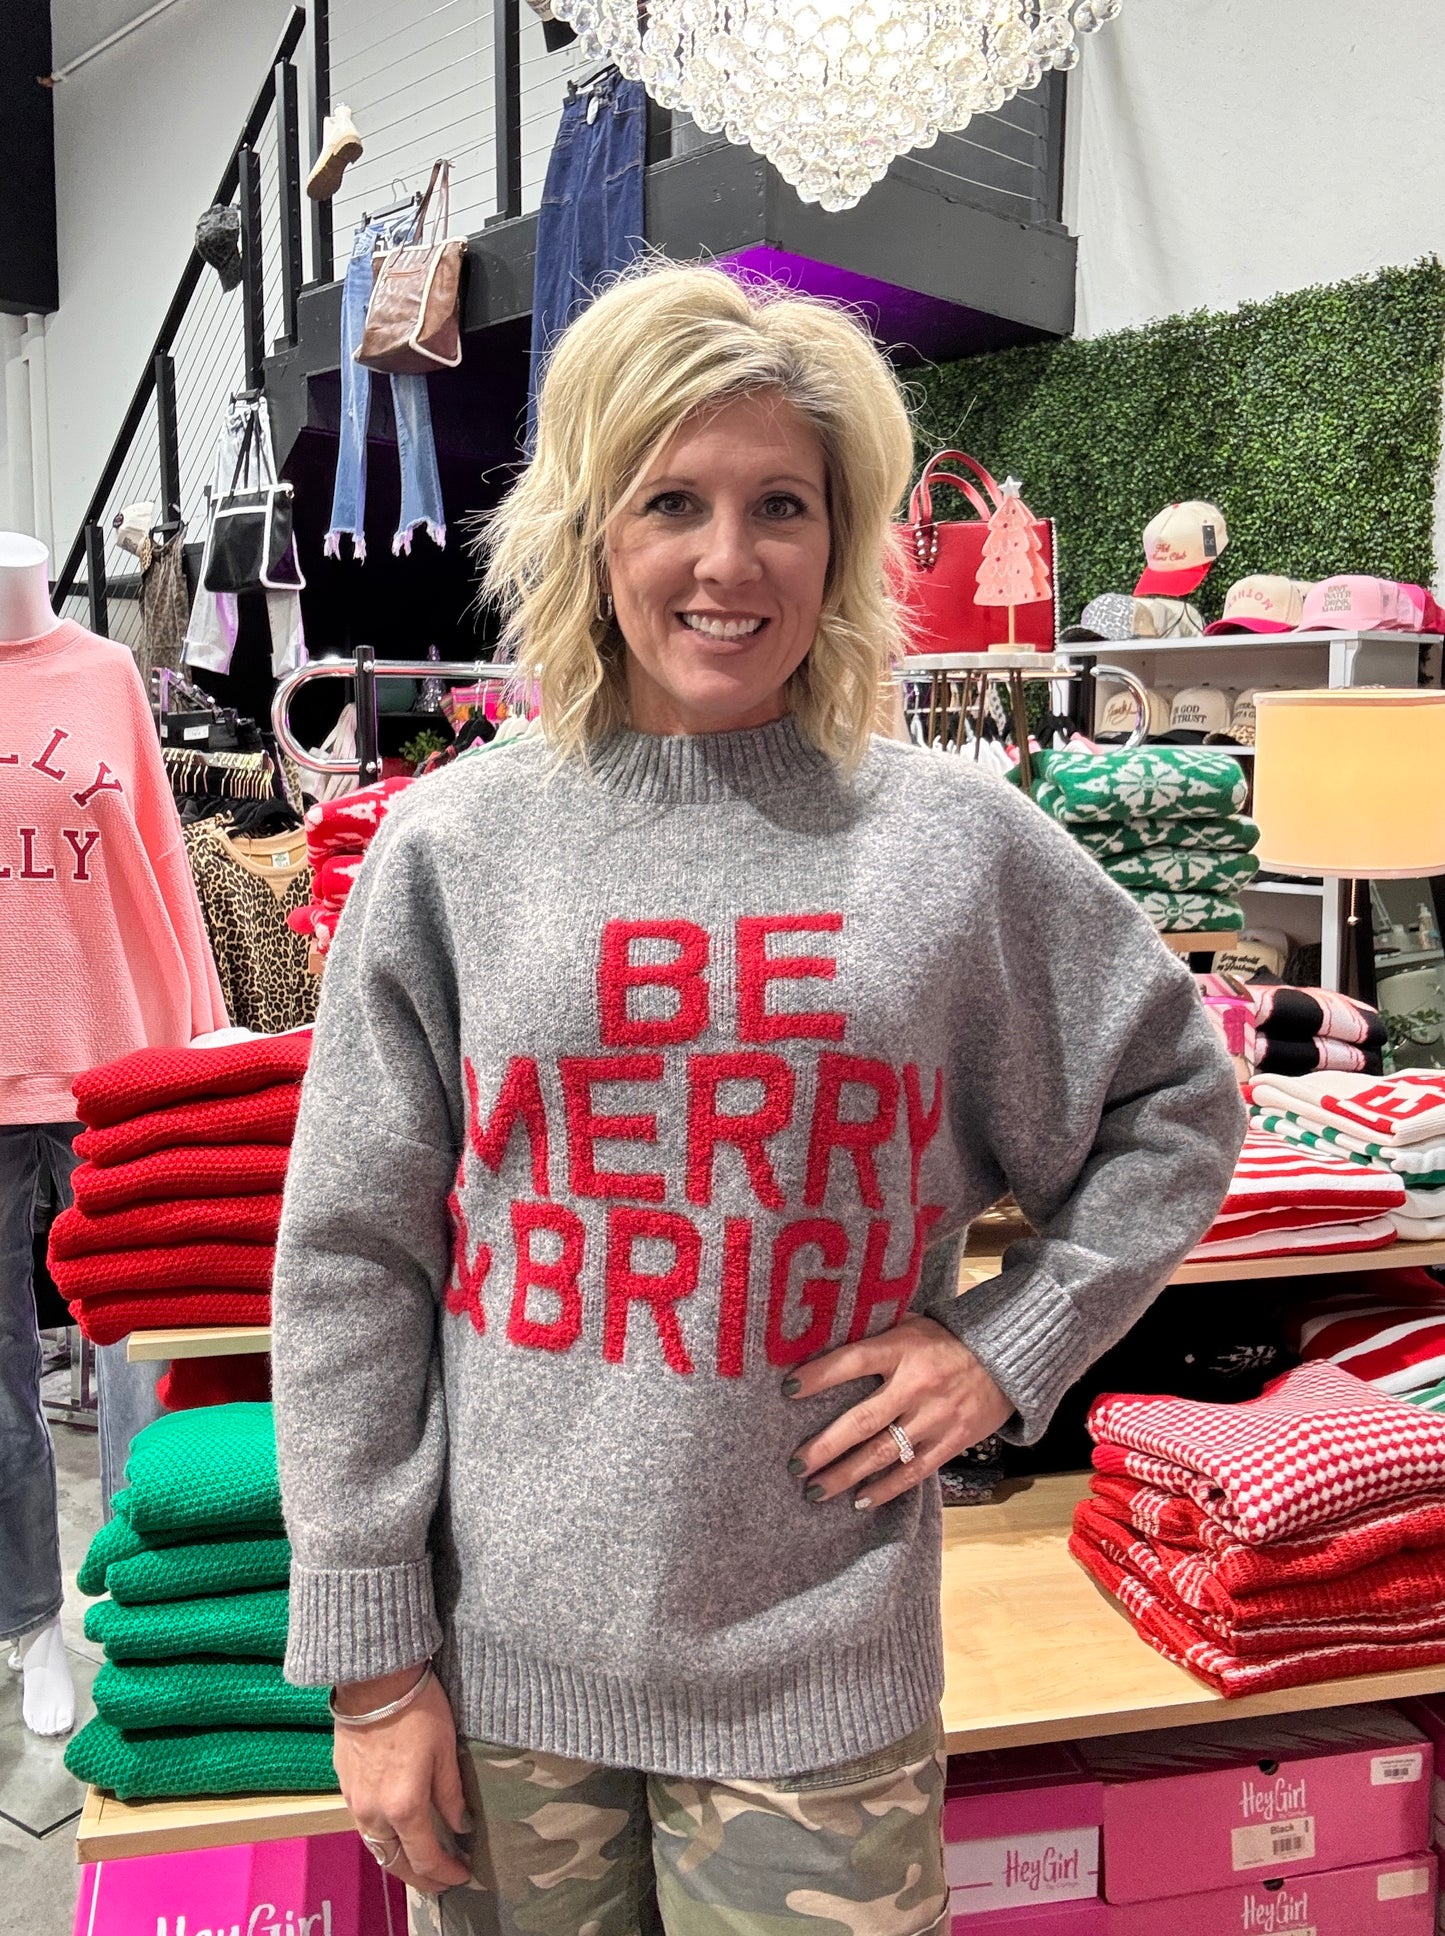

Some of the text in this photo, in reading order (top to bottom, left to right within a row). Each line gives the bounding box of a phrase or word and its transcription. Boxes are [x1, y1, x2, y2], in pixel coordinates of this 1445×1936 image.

[1178, 714, 1207, 724] TRUST
[1181, 704, 1200, 713] GOD
[0, 728, 123, 807] LY
[0, 828, 100, 880] LY
[597, 912, 845, 1046] BE
[455, 1050, 944, 1210] MERRY
[1270, 1823, 1294, 1835] Black
